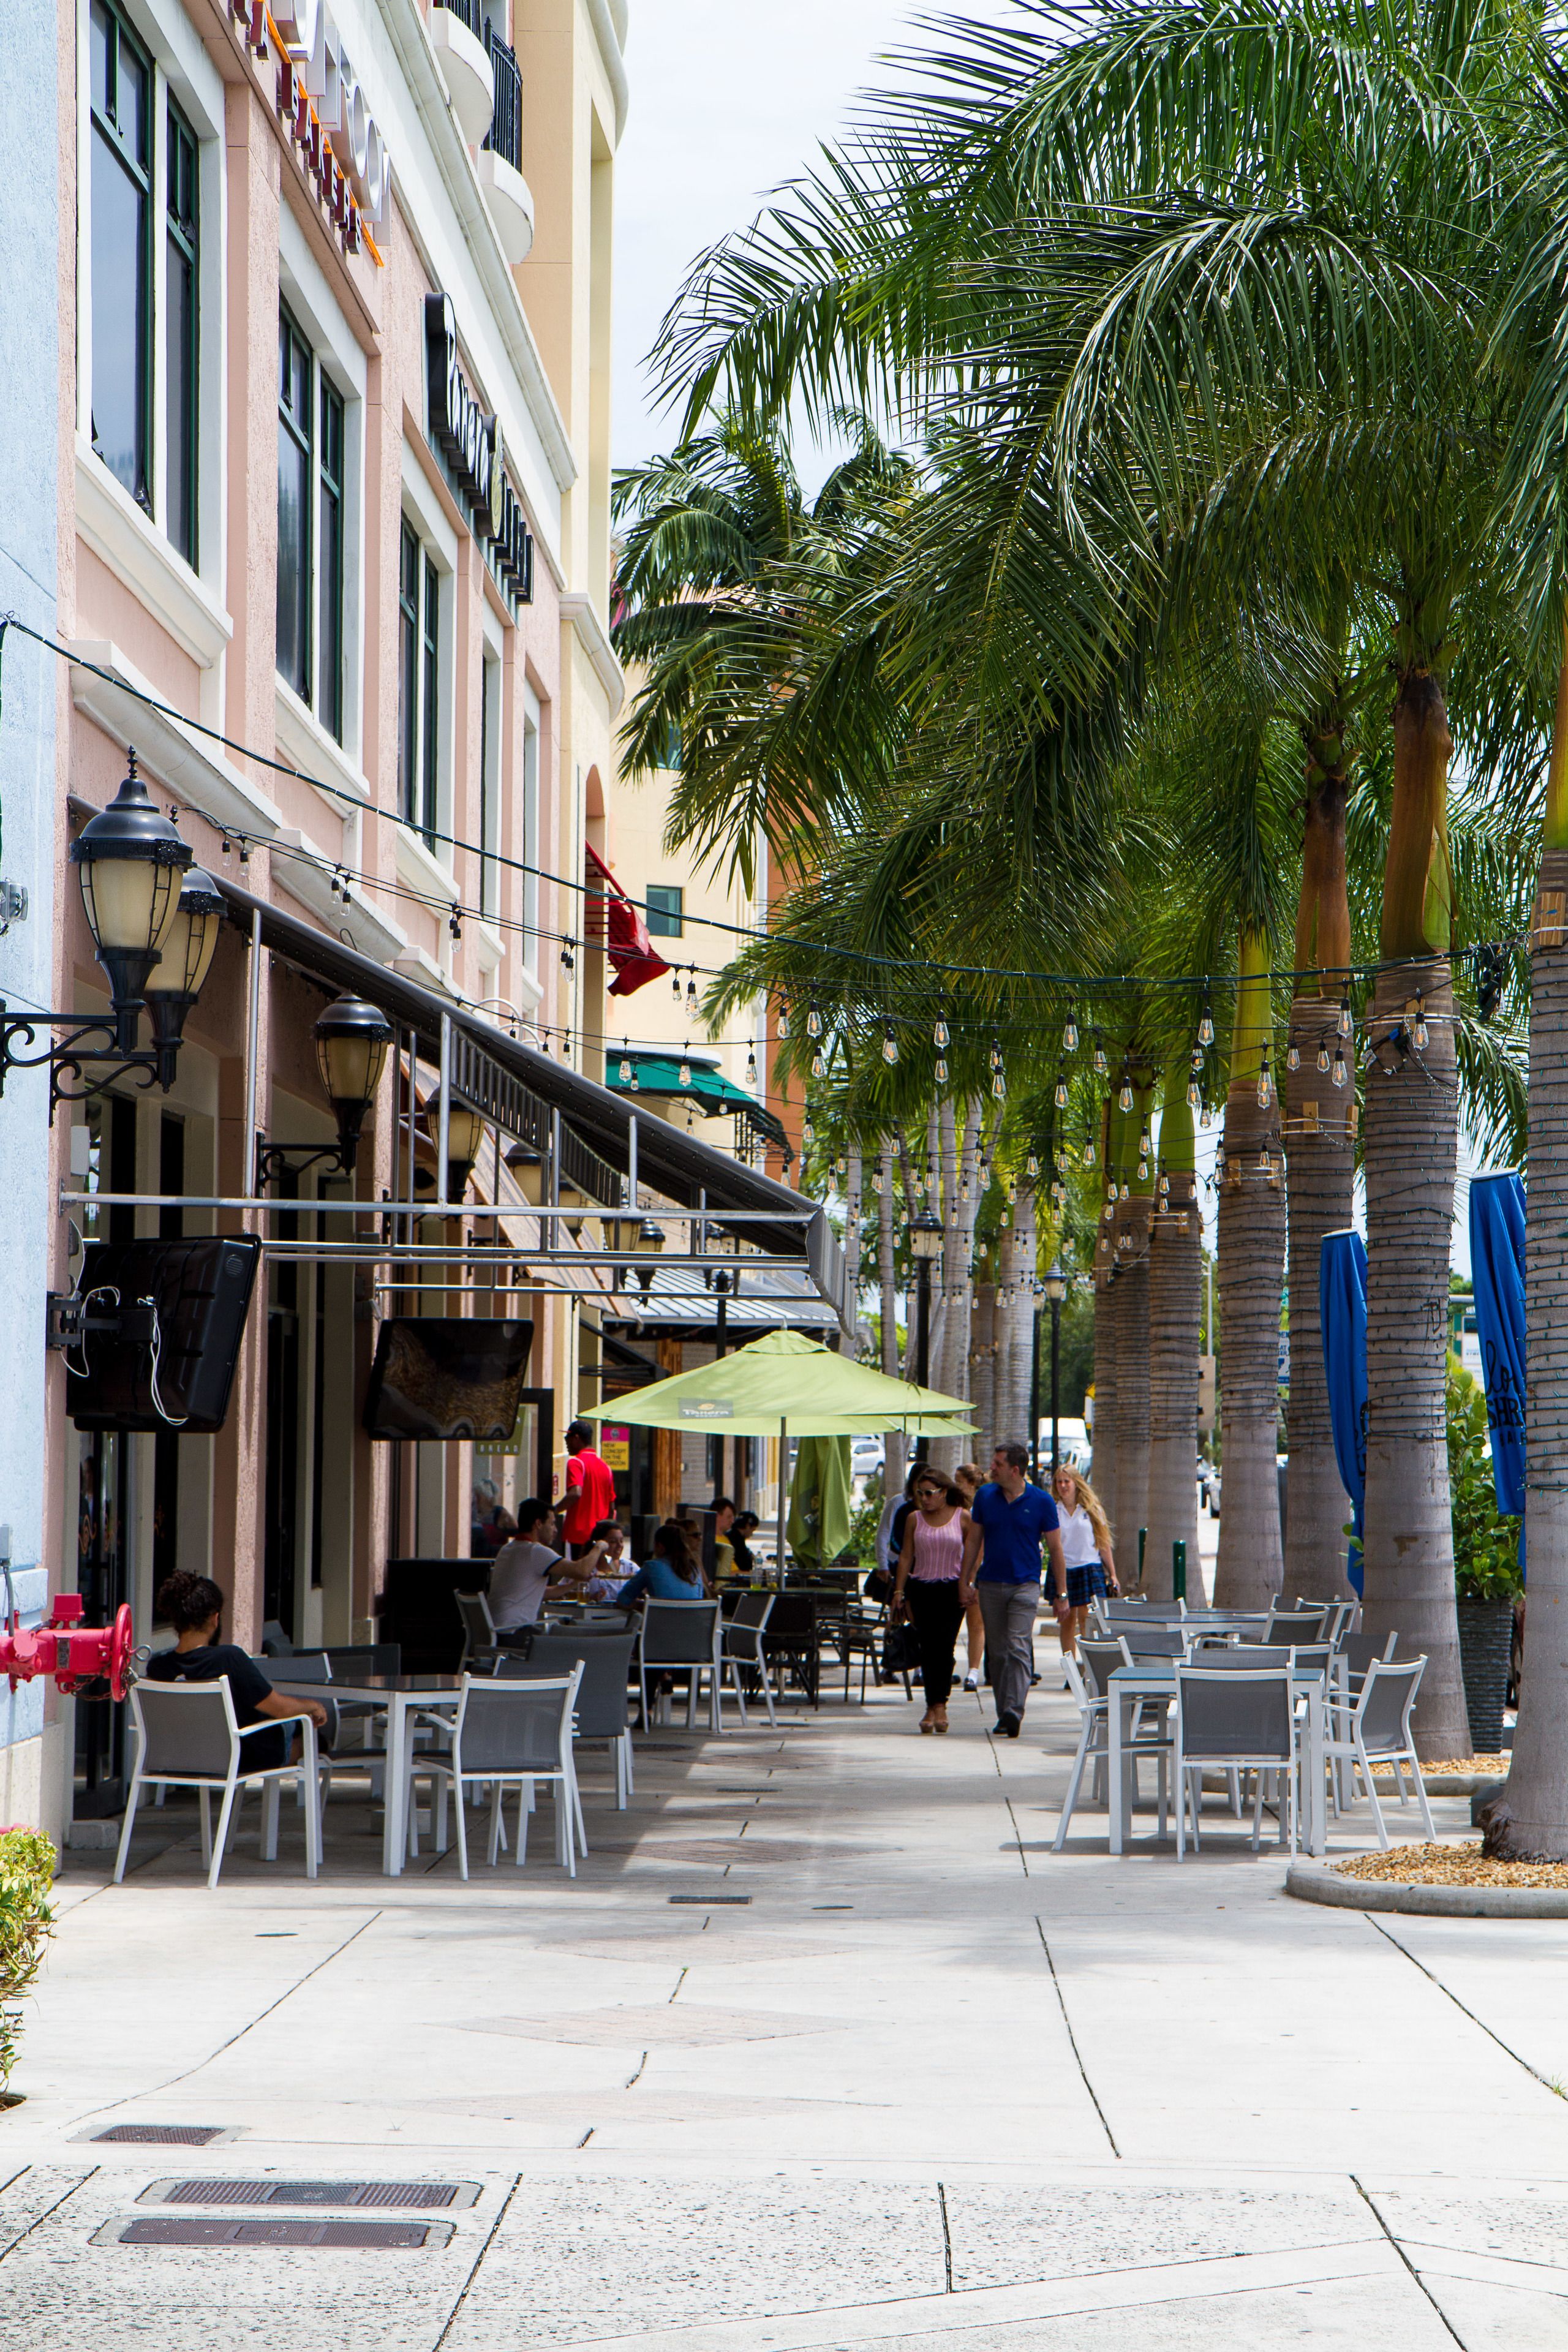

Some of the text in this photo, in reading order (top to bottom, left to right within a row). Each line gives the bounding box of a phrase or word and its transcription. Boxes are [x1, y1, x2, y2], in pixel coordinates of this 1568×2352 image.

[282, 62, 362, 255] BAKERS
[426, 293, 489, 510] Panera
[480, 1444, 519, 1453] BREAD
